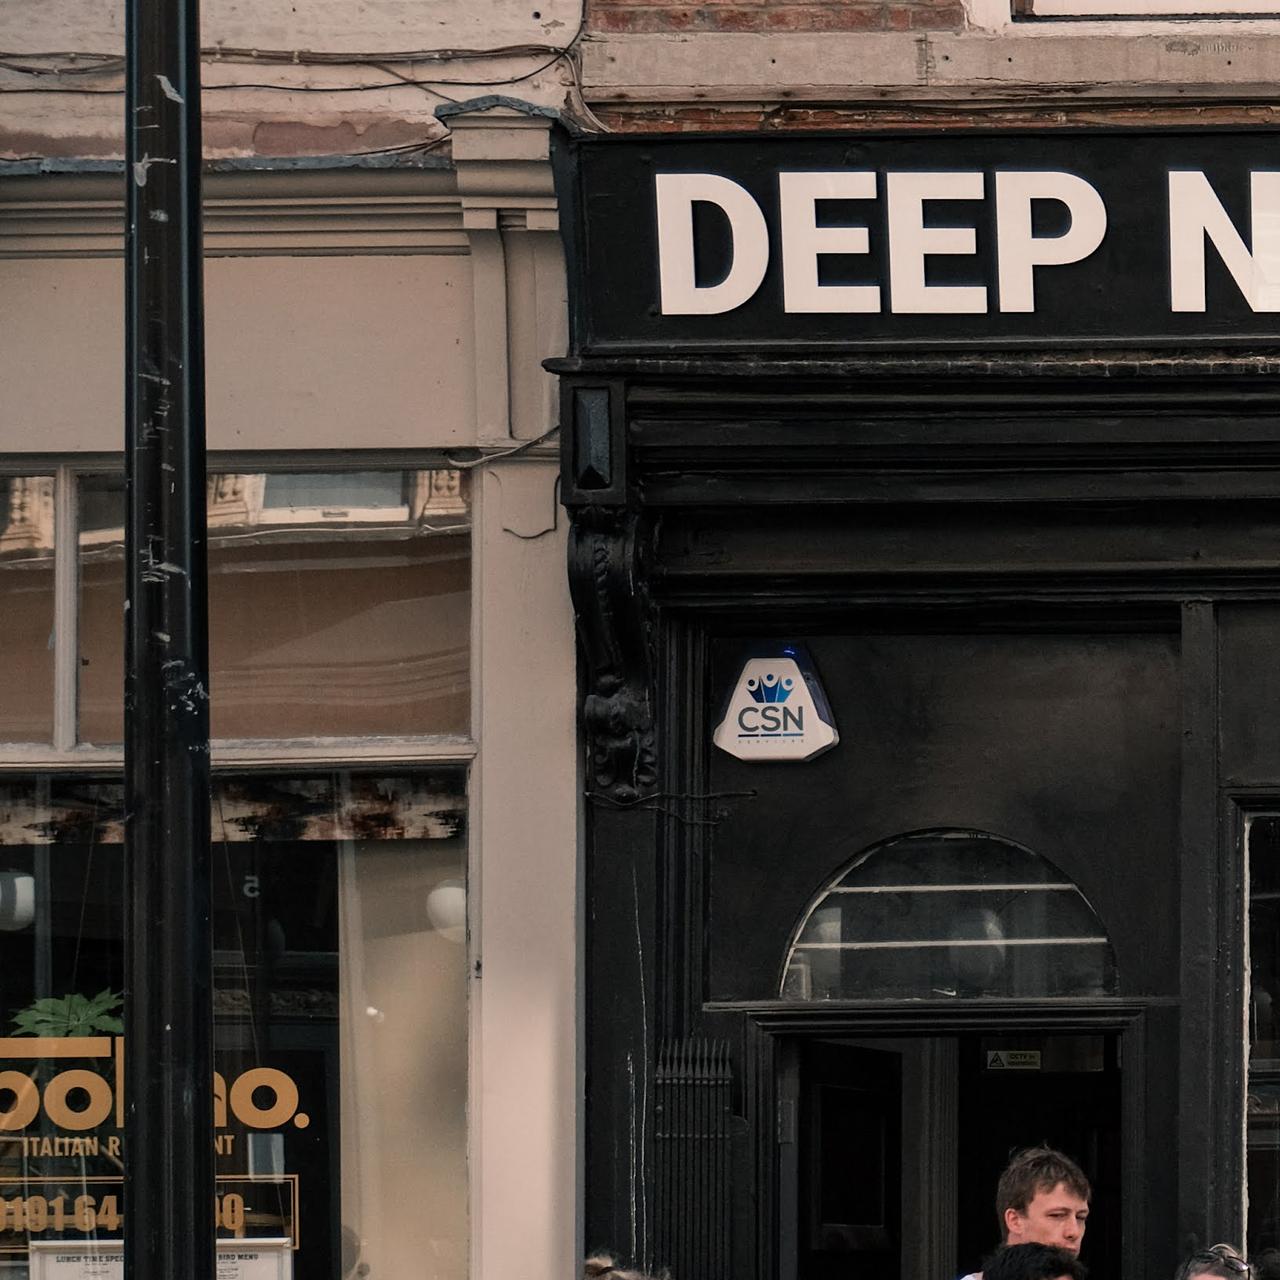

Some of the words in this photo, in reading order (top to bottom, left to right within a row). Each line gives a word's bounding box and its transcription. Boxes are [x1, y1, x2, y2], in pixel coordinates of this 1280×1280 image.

[655, 170, 1108, 316] DEEP
[737, 706, 804, 732] CSN
[23, 1136, 98, 1157] ITALIAN
[0, 1195, 65, 1231] 191
